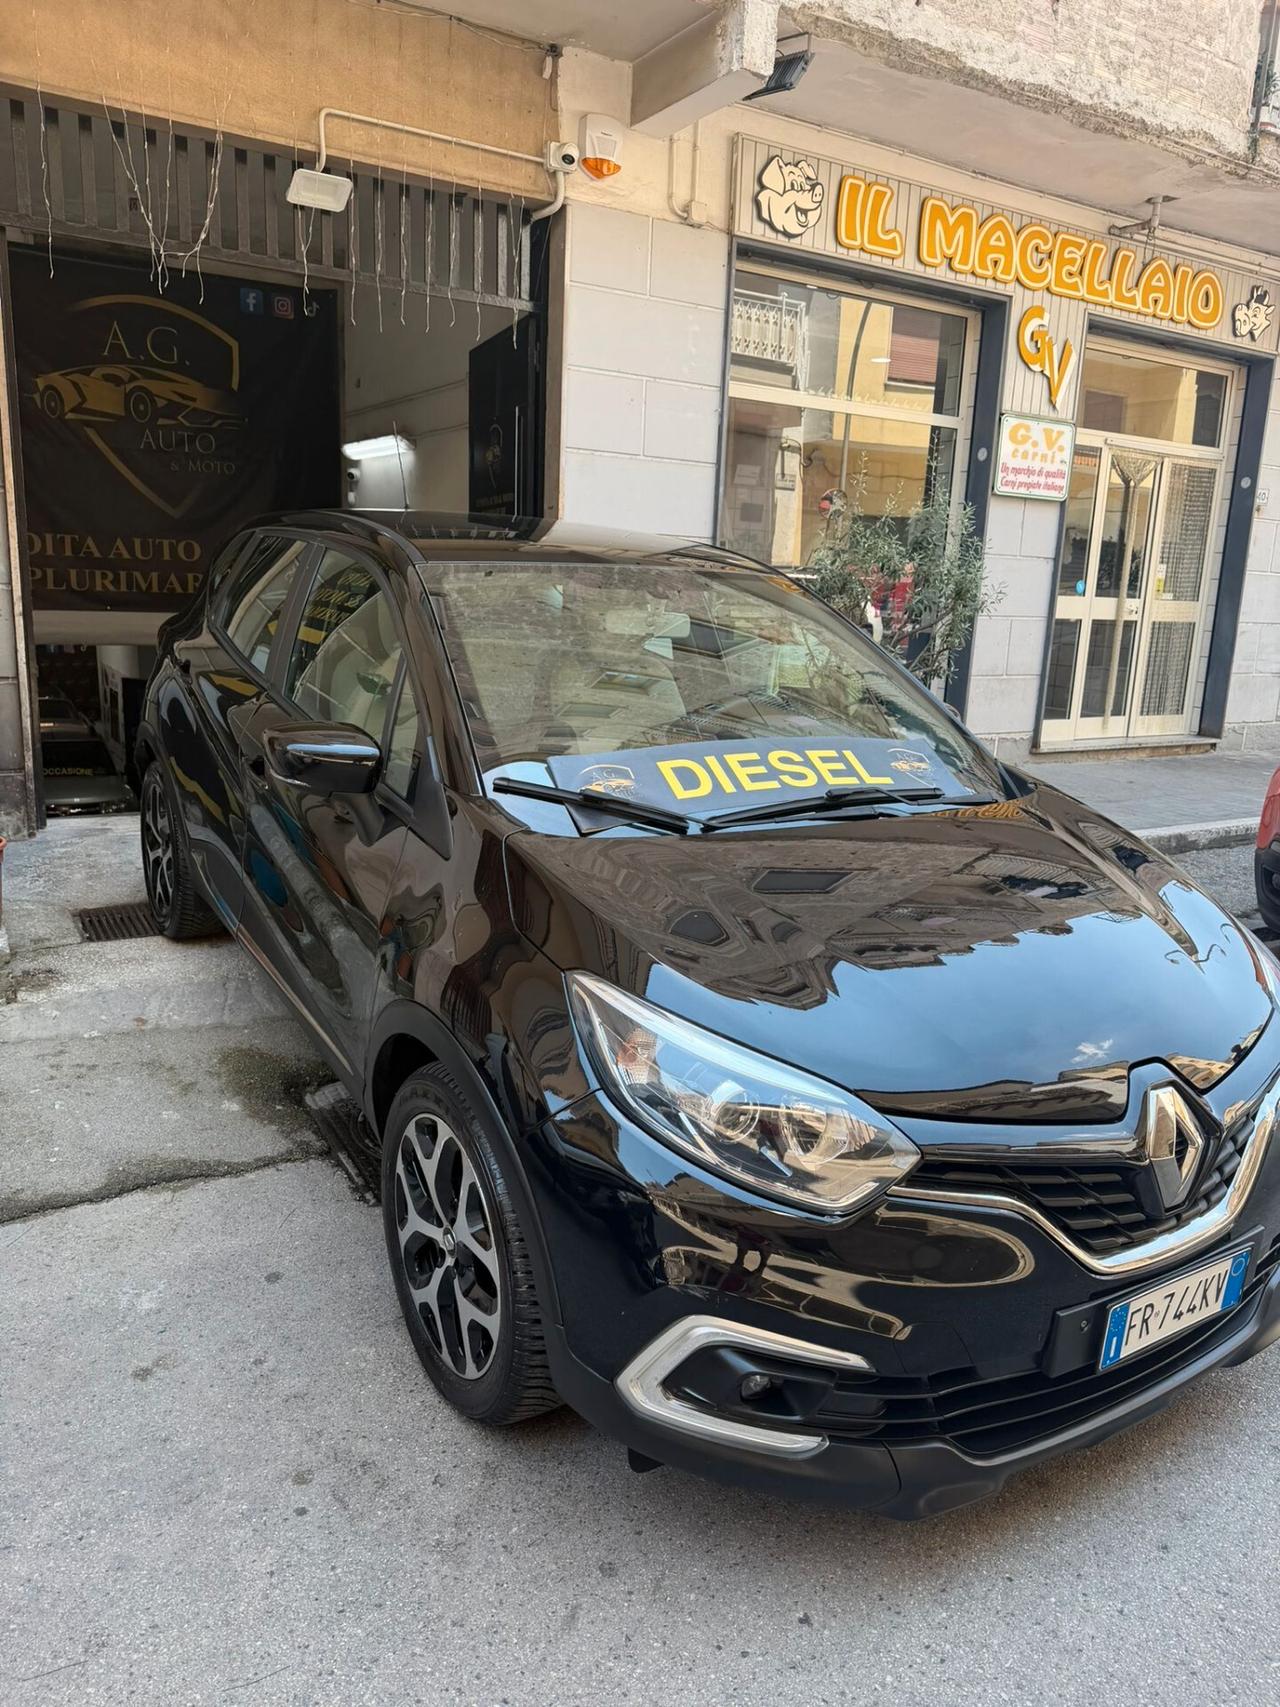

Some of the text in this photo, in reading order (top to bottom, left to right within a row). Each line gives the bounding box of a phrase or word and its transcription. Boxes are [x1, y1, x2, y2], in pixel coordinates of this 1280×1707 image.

[838, 175, 1223, 329] IL MACELLAIO
[102, 320, 191, 365] A.G.
[139, 428, 217, 454] AUTO
[1009, 422, 1065, 453] G.V.
[170, 458, 236, 475] & MOTO
[1011, 447, 1056, 463] carni
[1000, 462, 1010, 476] Un
[1011, 465, 1037, 478] marchio
[1037, 466, 1044, 477] di
[1000, 476, 1017, 489] Carni
[1017, 479, 1042, 491] pregiate
[26, 532, 202, 562] DITA AUTO
[656, 749, 894, 800] DIESEL
